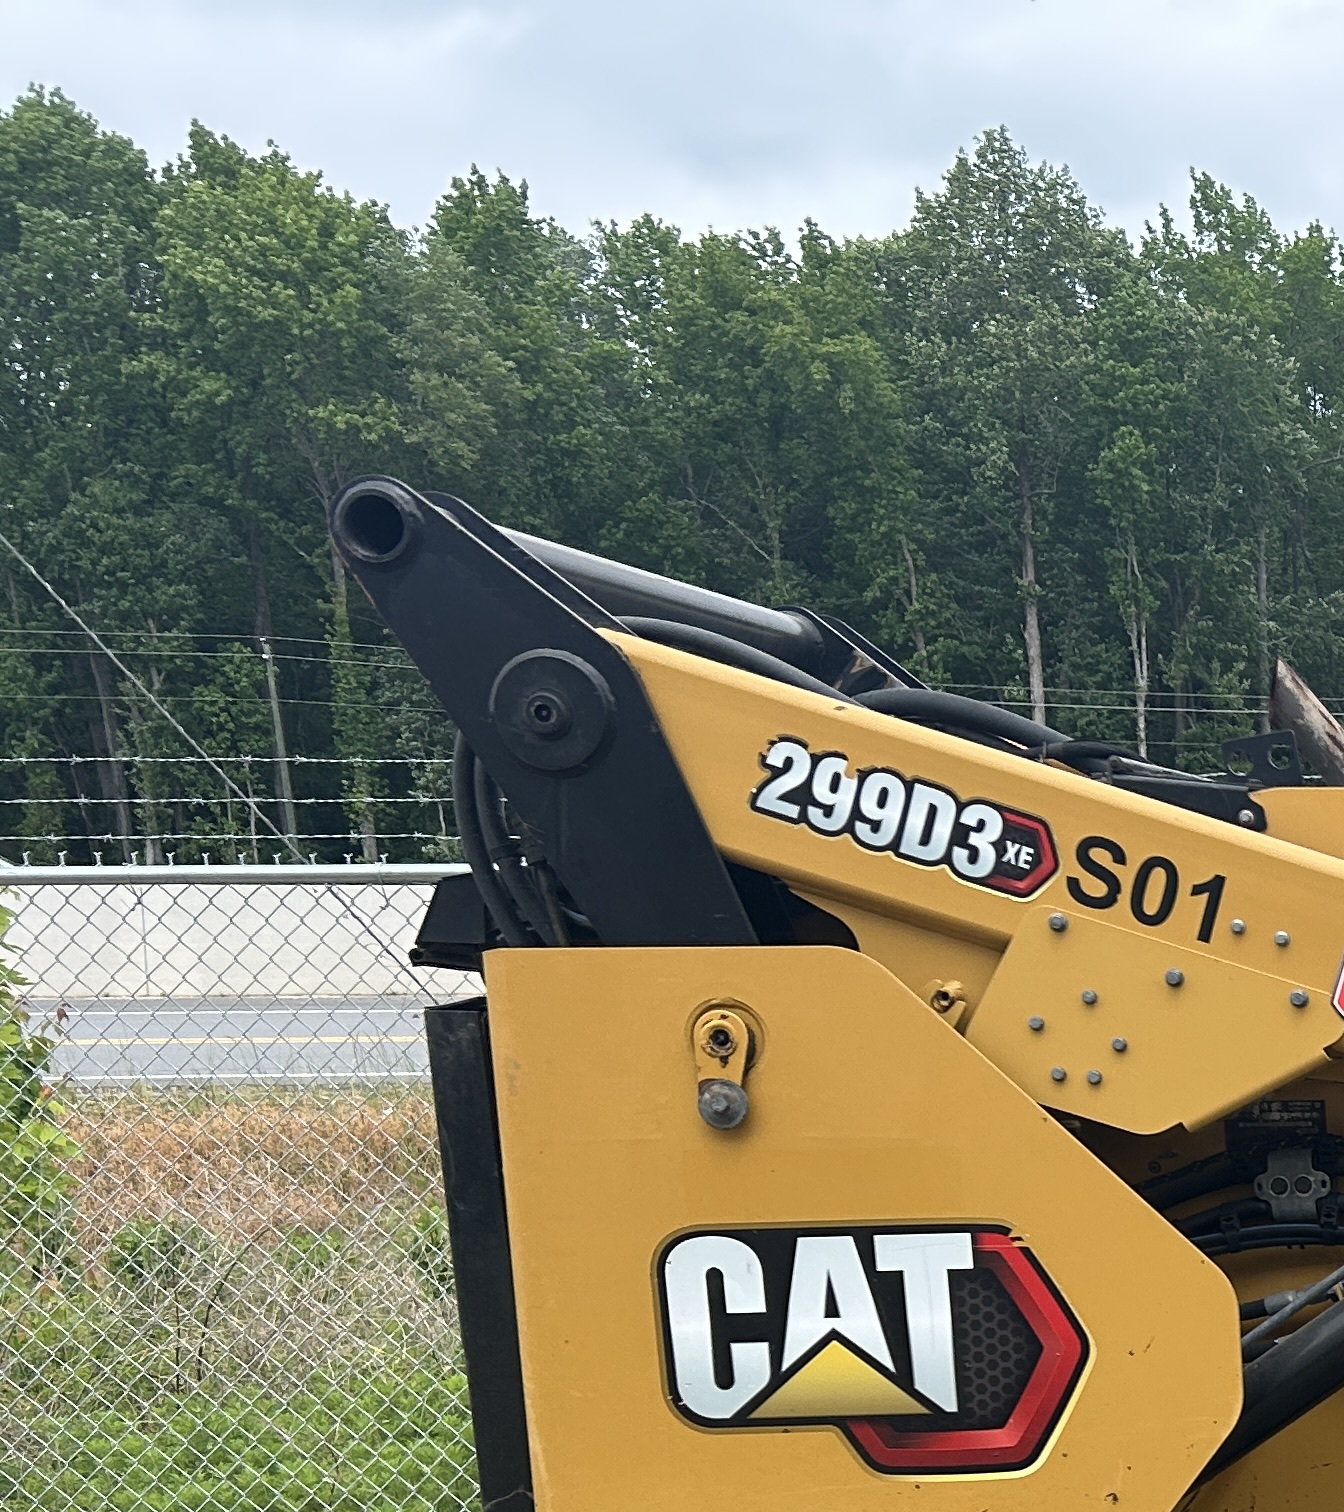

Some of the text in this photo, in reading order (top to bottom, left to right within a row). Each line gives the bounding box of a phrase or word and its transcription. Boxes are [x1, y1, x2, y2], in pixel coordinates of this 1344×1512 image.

[755, 741, 1035, 880] 299D3 XE
[1066, 836, 1228, 944] S01
[664, 1232, 975, 1419] CAT
